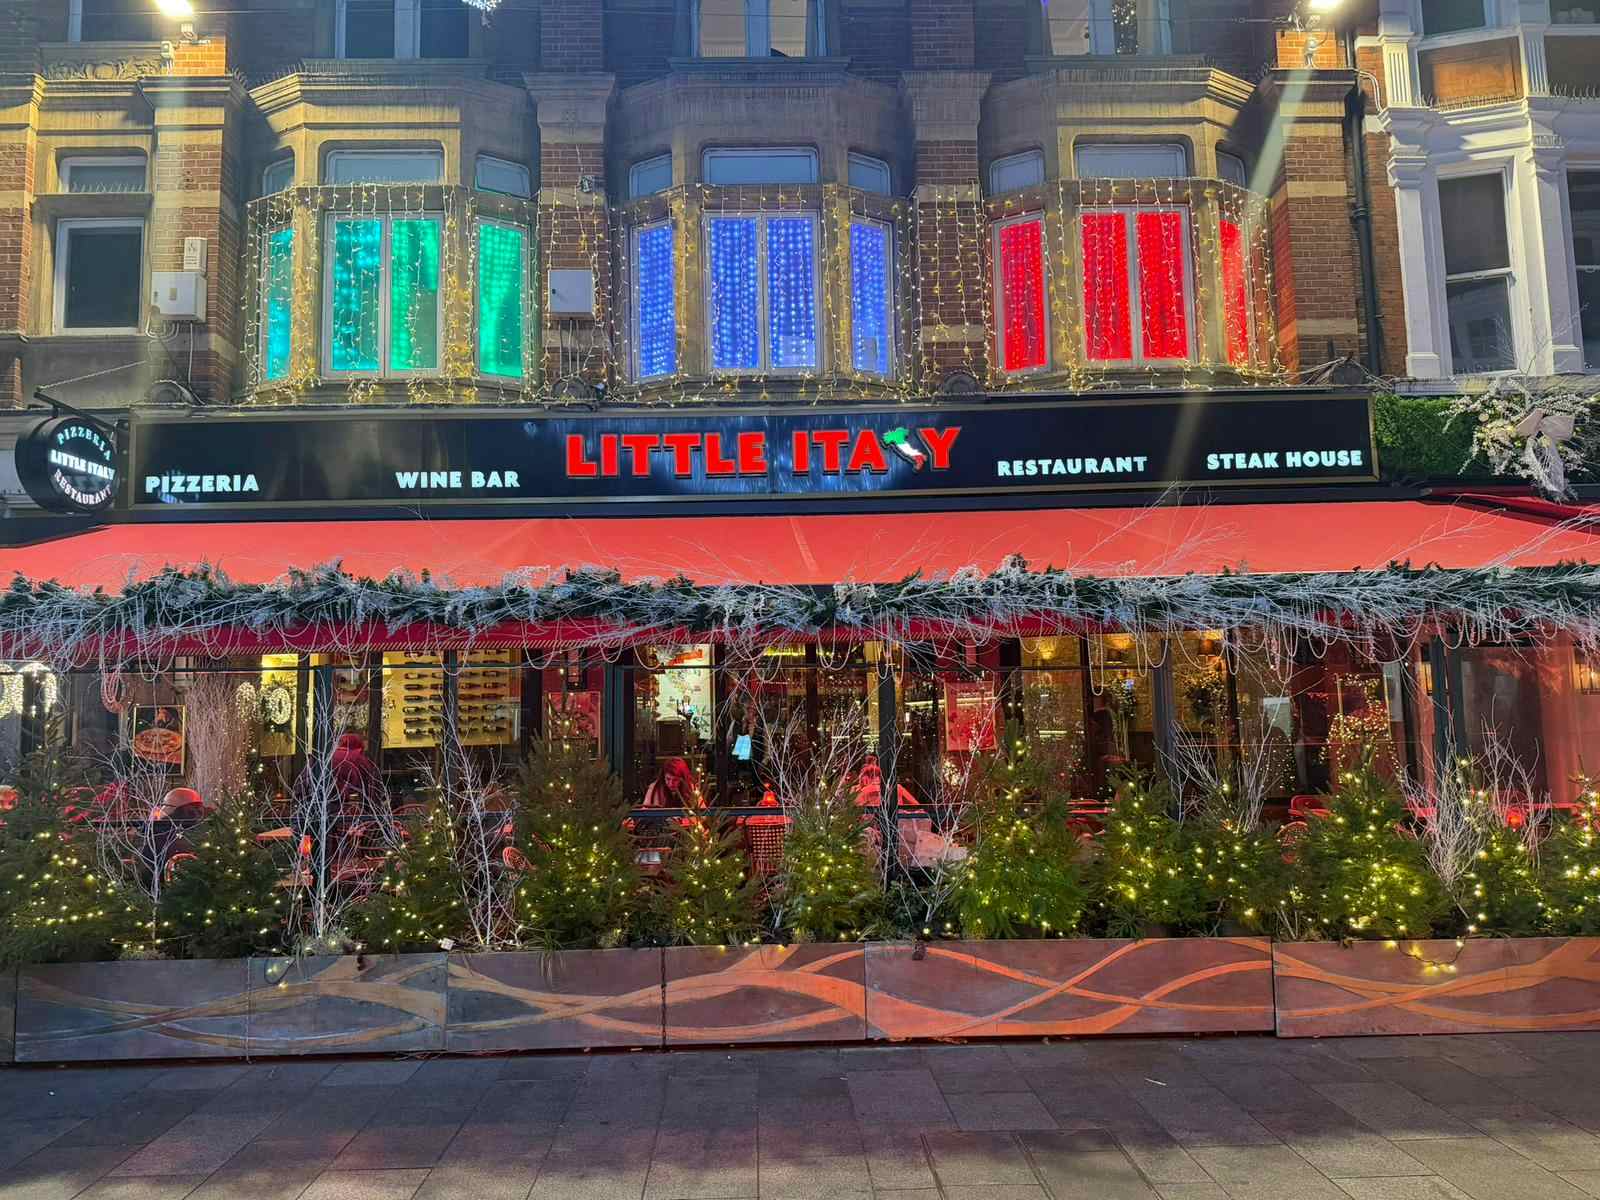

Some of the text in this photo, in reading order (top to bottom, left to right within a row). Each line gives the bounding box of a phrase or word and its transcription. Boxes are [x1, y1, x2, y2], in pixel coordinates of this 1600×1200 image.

[57, 425, 112, 461] PIZZERIA
[565, 432, 768, 480] LITTLE
[50, 449, 116, 481] LITTLE ITALY
[997, 456, 1148, 477] RESTAURANT
[1206, 450, 1363, 471] STEAK HOUSE
[54, 467, 112, 505] RESTAURANT
[145, 474, 260, 495] PIZZERIA
[395, 470, 521, 489] WINE BAR
